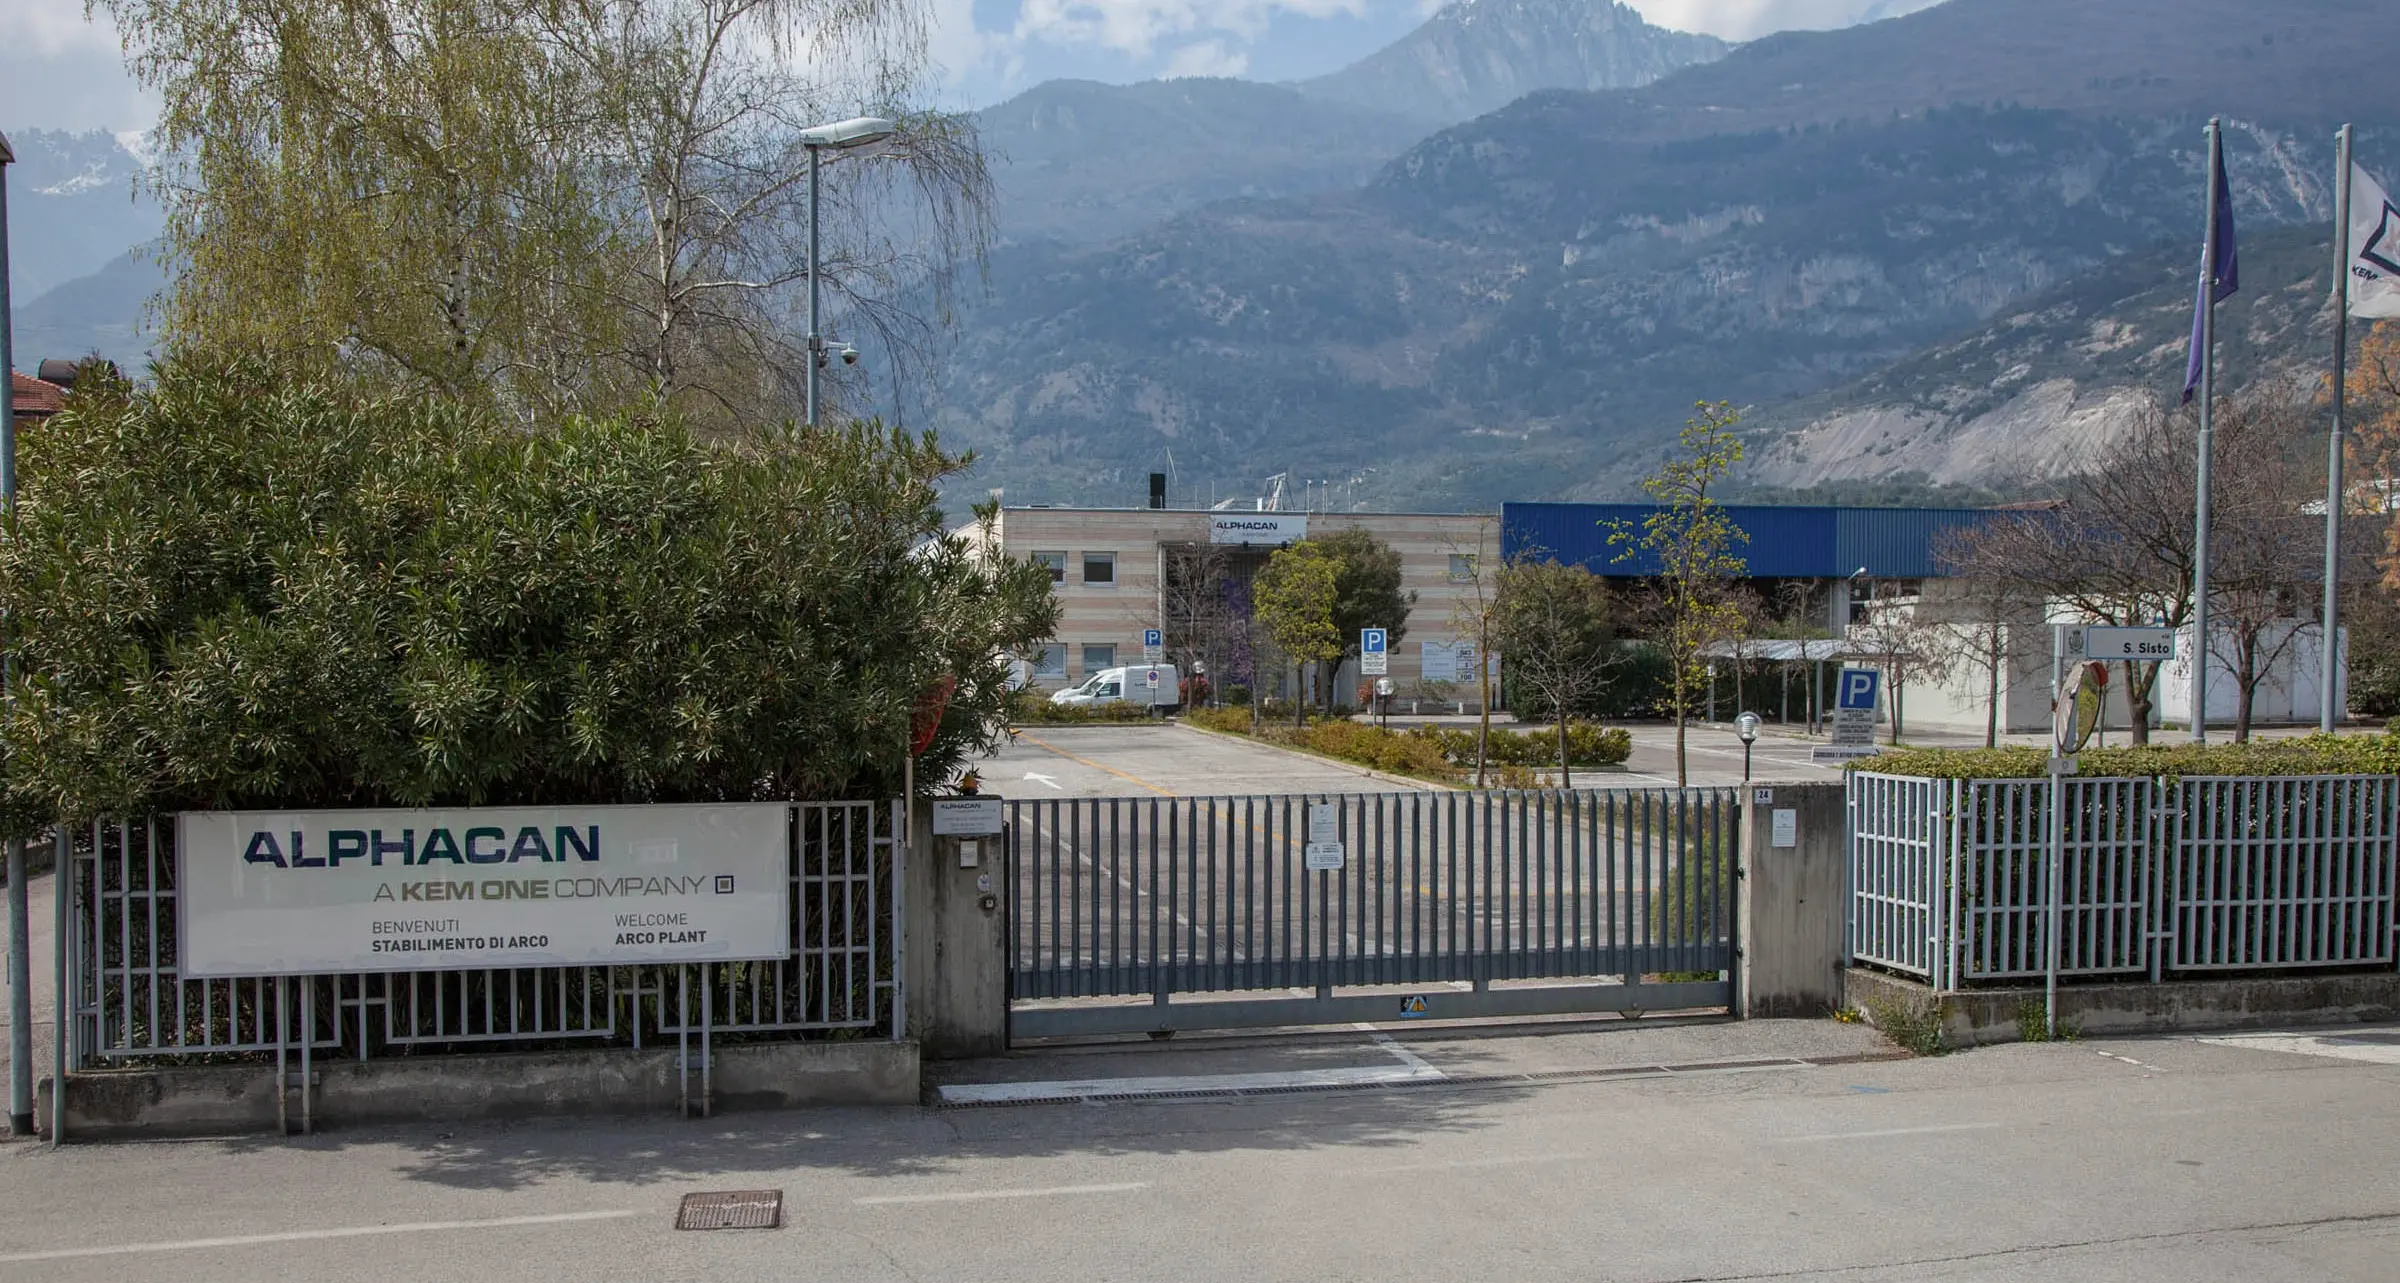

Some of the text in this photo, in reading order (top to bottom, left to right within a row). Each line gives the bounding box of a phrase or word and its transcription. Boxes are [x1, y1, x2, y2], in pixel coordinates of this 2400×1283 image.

[1216, 522, 1278, 530] ALPHACAN
[1148, 631, 1158, 645] P
[1368, 632, 1381, 650] P
[2123, 643, 2169, 654] S. Sisto
[1848, 674, 1871, 705] P
[243, 826, 600, 868] ALPHACAN
[373, 875, 707, 902] A KEM ONE COMPANY
[372, 919, 460, 934] BENVENUTI
[615, 912, 688, 927] WELCOME
[372, 935, 549, 952] STABILIMENTO DI ARCO
[615, 930, 707, 945] ARCO PLANT
